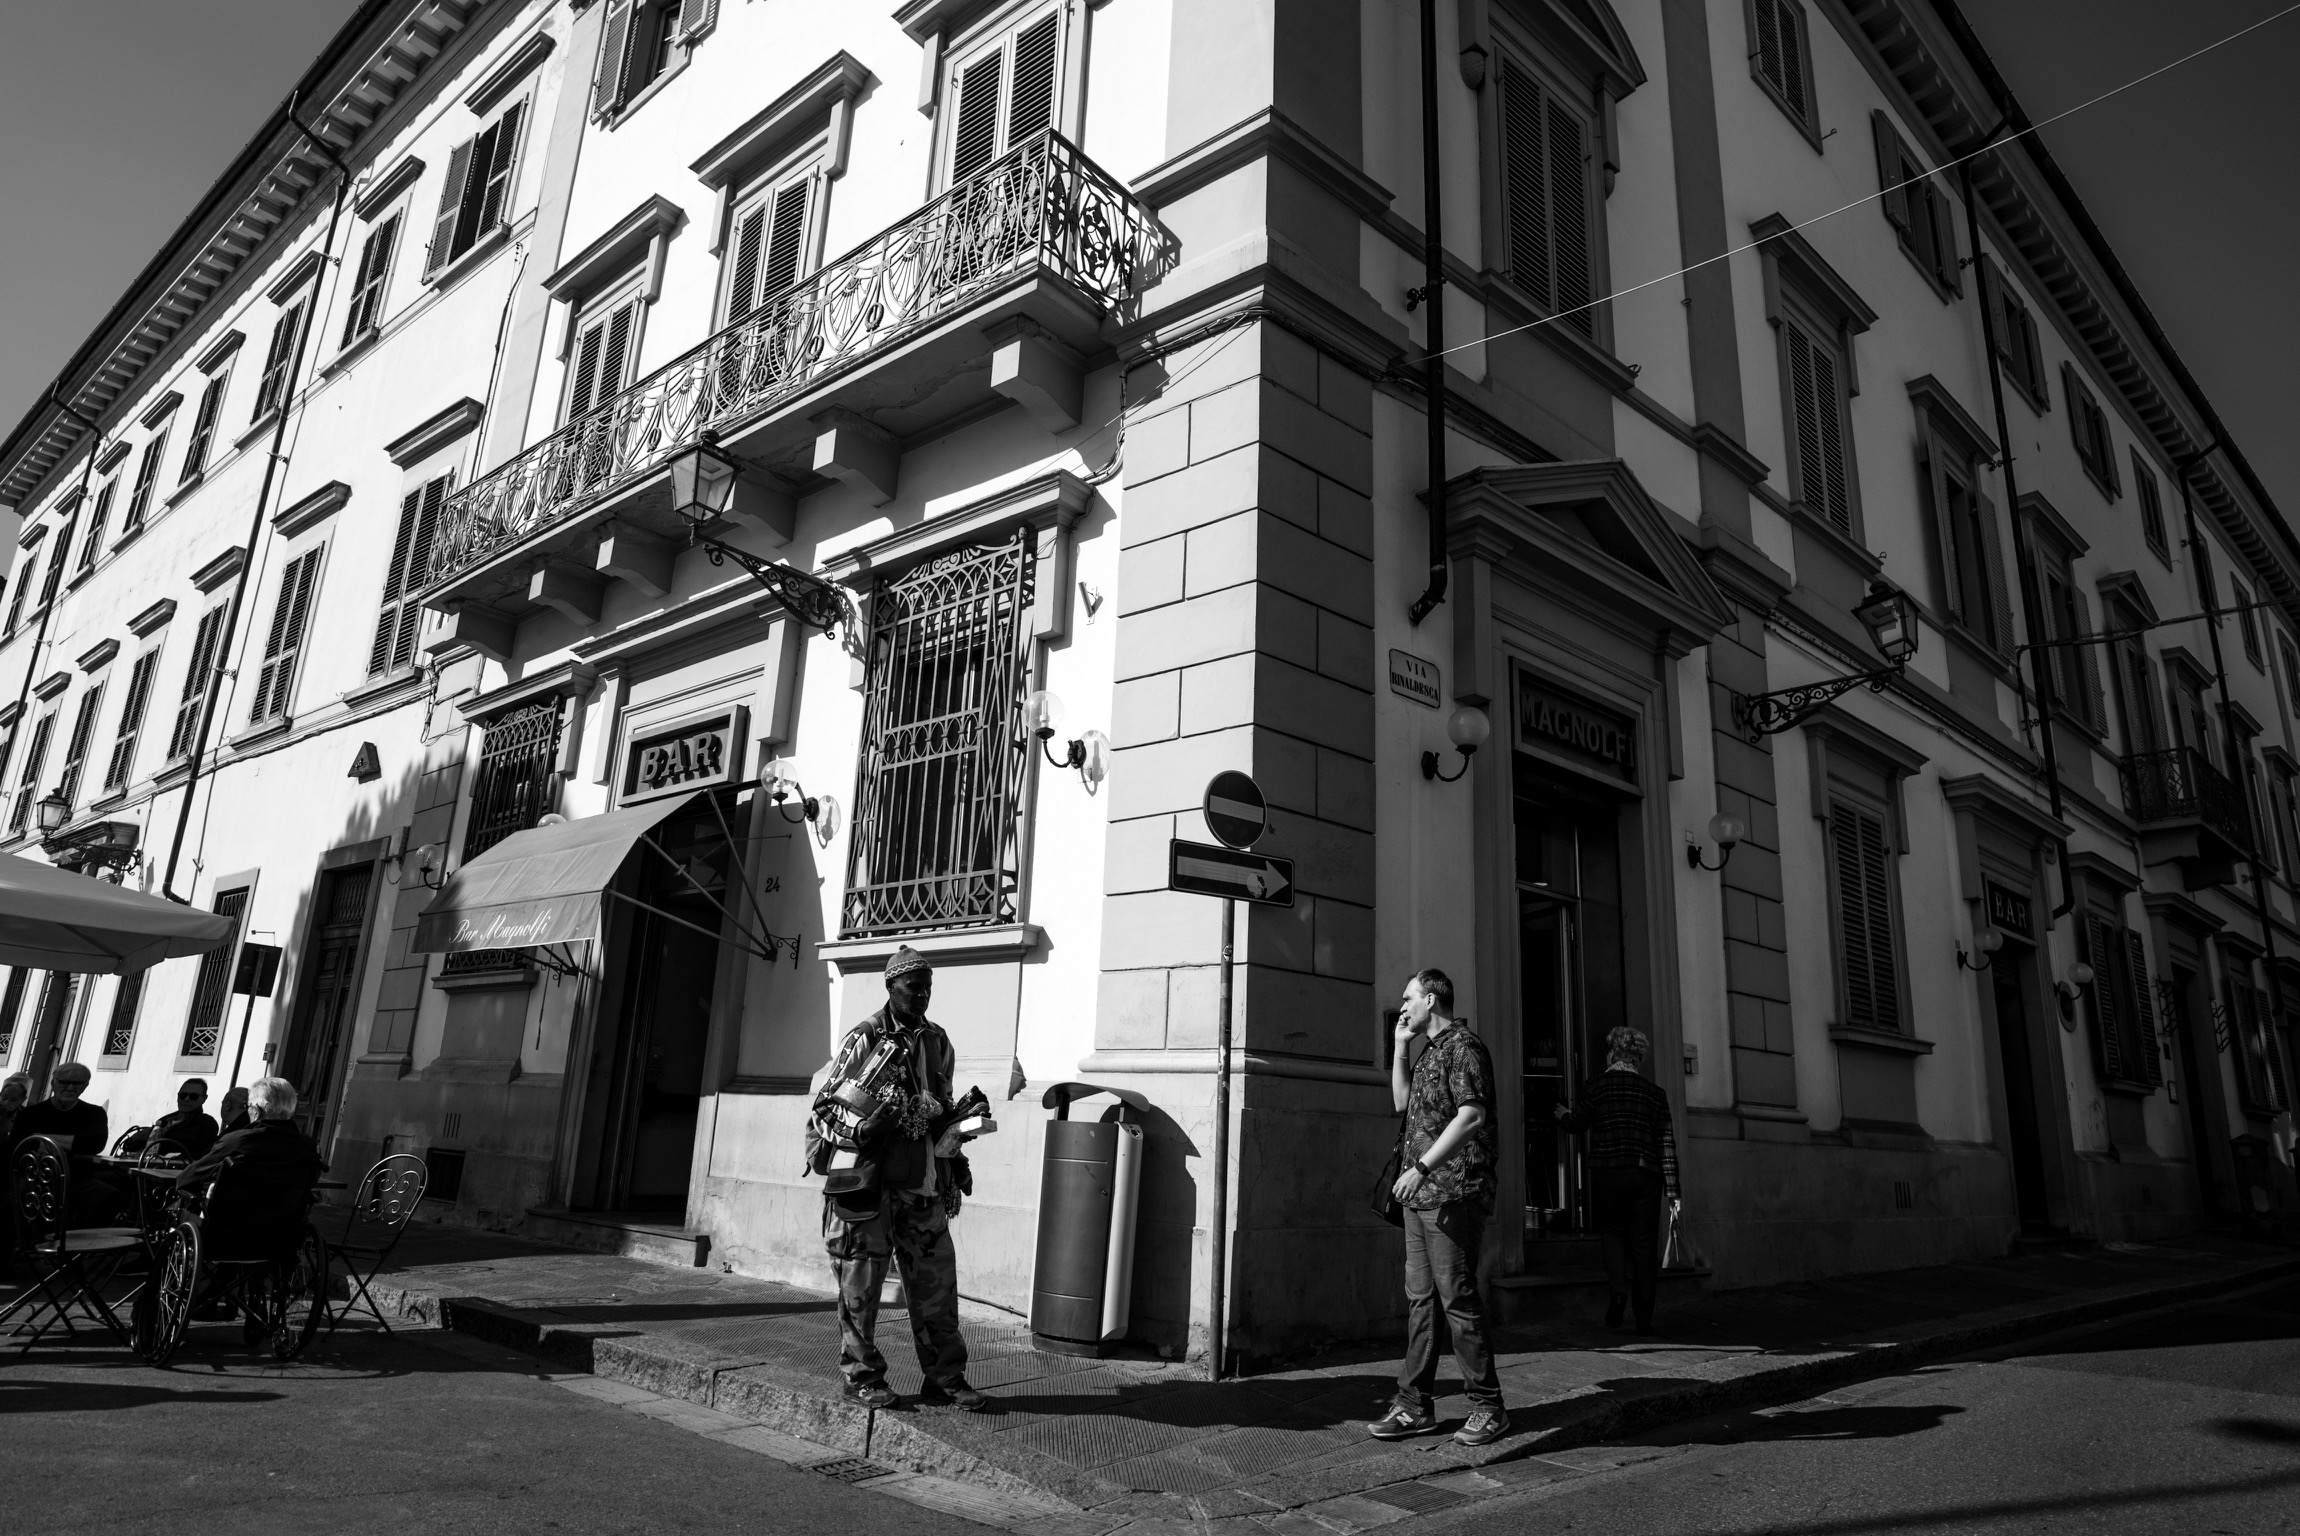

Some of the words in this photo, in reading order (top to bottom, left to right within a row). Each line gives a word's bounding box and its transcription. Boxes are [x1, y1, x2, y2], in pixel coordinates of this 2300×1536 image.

[1406, 660, 1426, 678] VIA
[1392, 672, 1438, 701] RINALDESCA
[1521, 692, 1635, 768] MAGNOLFI
[641, 732, 715, 782] BAR
[765, 877, 780, 892] 24
[1994, 890, 2027, 929] BAR
[449, 919, 479, 943] Bar
[480, 909, 552, 945] Magnolfi
[1396, 1412, 1413, 1426] N
